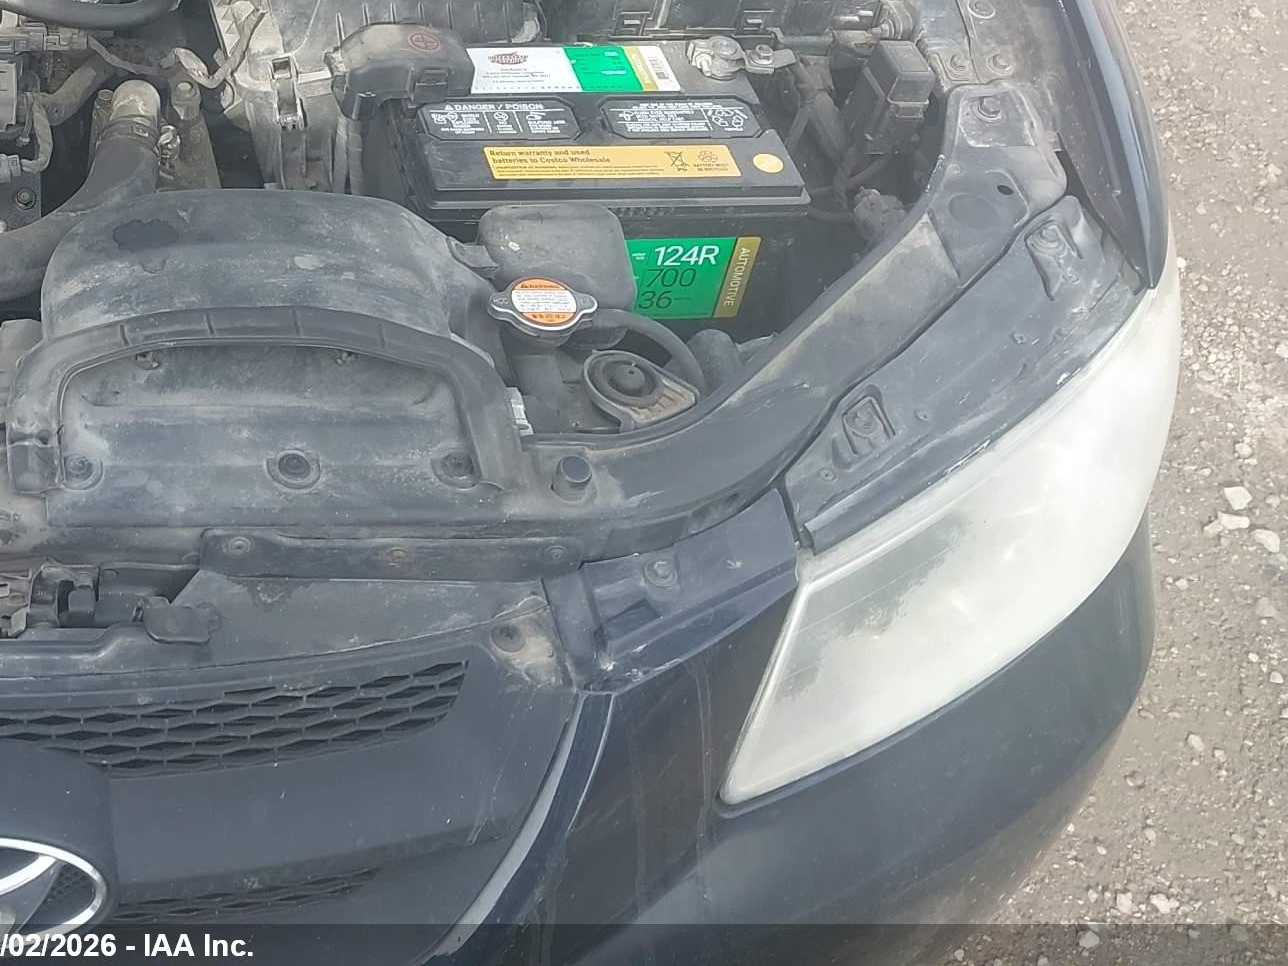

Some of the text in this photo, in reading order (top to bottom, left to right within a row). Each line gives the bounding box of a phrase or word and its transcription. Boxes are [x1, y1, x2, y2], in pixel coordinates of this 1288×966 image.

[654, 245, 720, 266] 124R
[647, 268, 697, 288] 700
[723, 247, 751, 307] AUTOMOTIVE
[638, 290, 673, 310] 36
